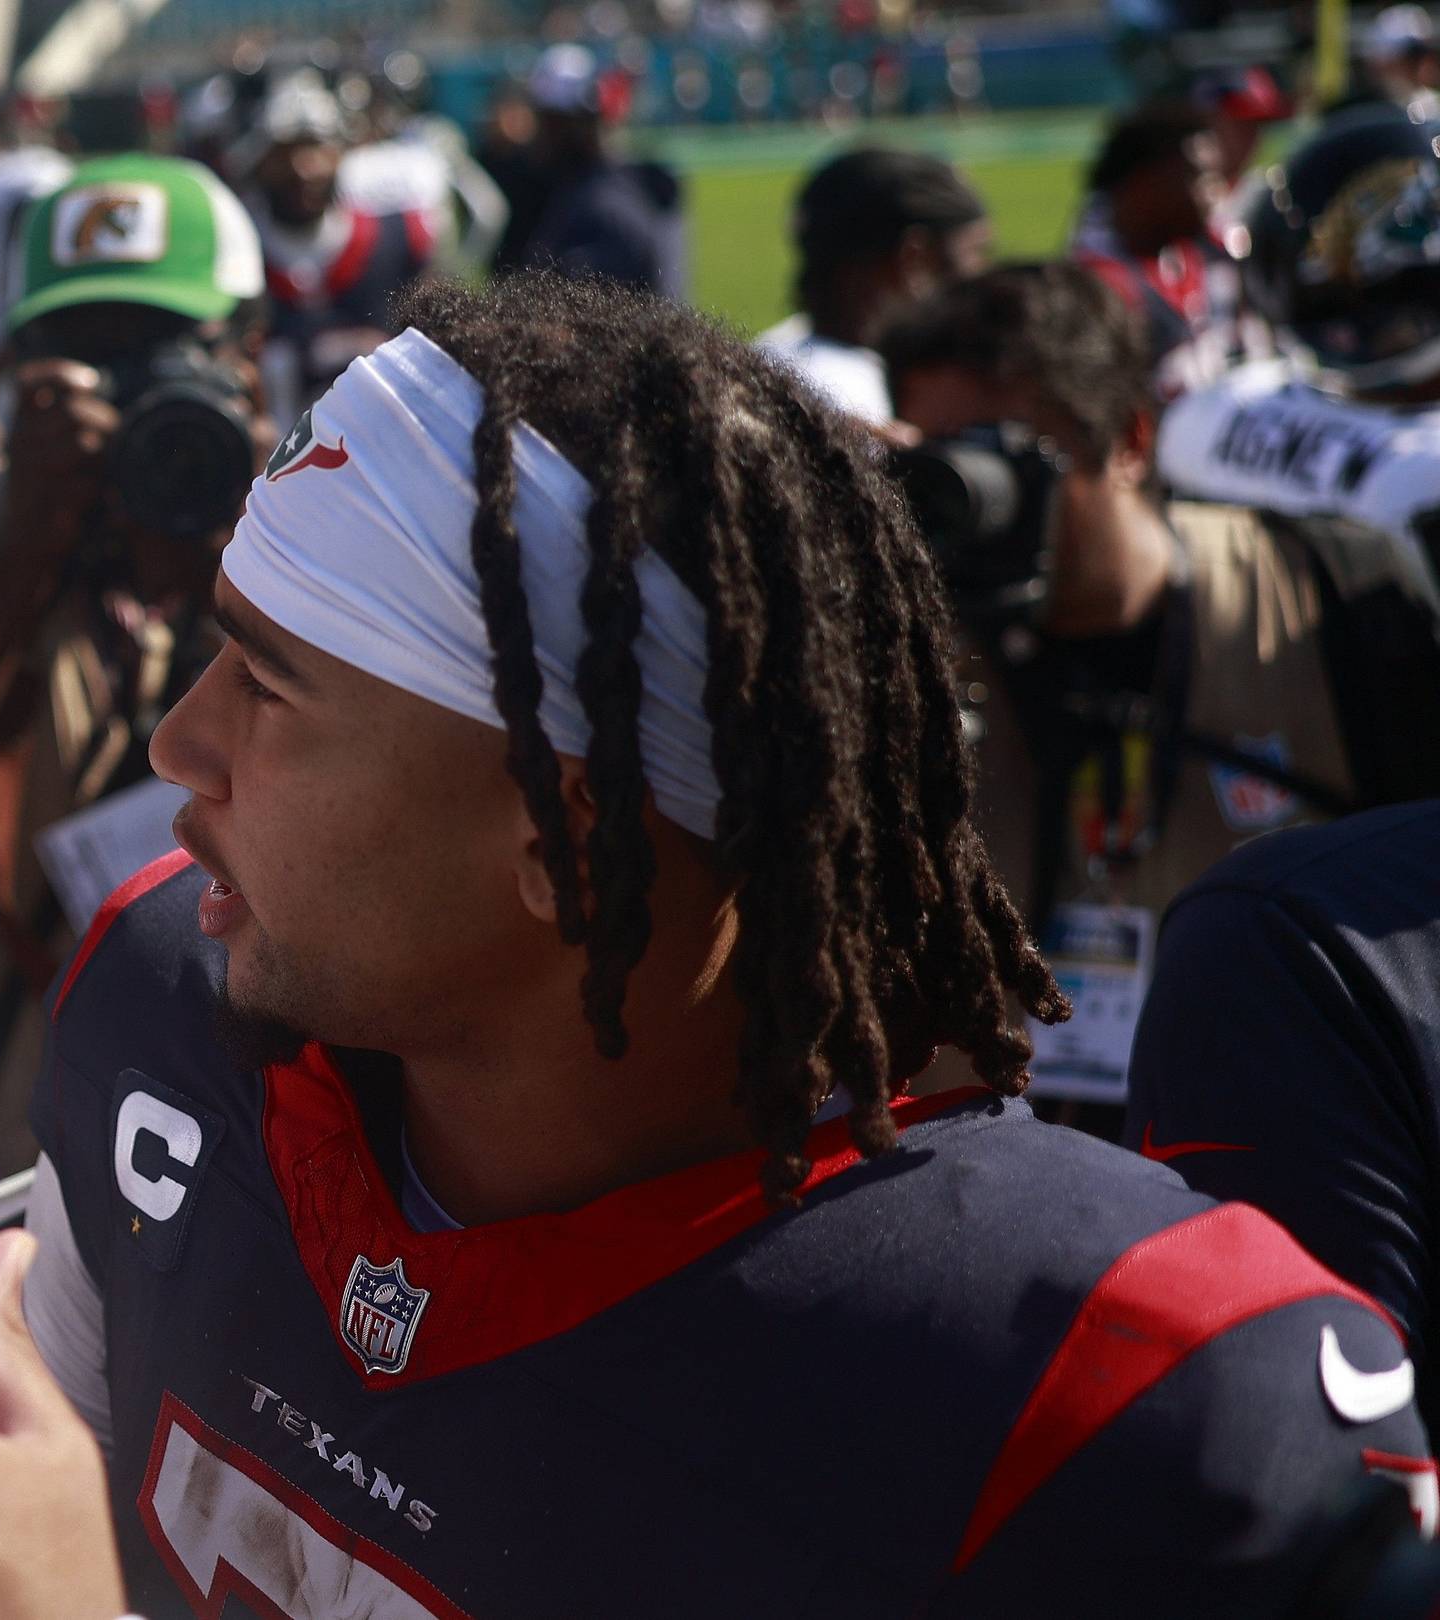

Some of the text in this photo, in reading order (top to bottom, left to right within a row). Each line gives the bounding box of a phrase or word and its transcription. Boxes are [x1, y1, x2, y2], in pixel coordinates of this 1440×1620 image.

[115, 1090, 202, 1222] C
[346, 1299, 396, 1360] NFL
[242, 1374, 440, 1532] TEXANS
